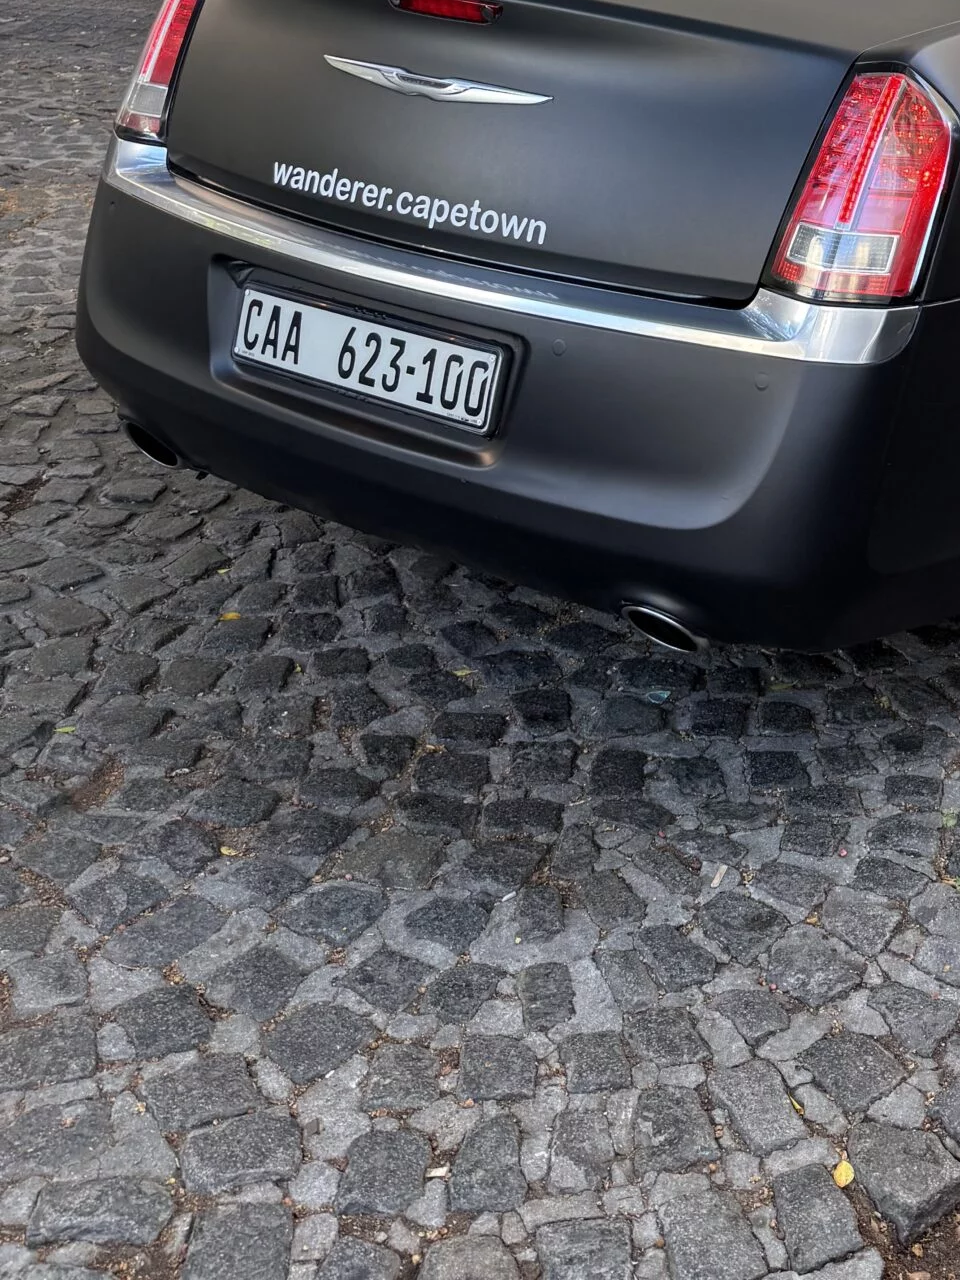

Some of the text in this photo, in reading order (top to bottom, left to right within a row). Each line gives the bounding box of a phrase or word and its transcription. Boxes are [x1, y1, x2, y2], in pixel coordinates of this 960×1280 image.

[273, 161, 547, 245] wanderer.capetown
[243, 299, 490, 417] CAA 623-100
